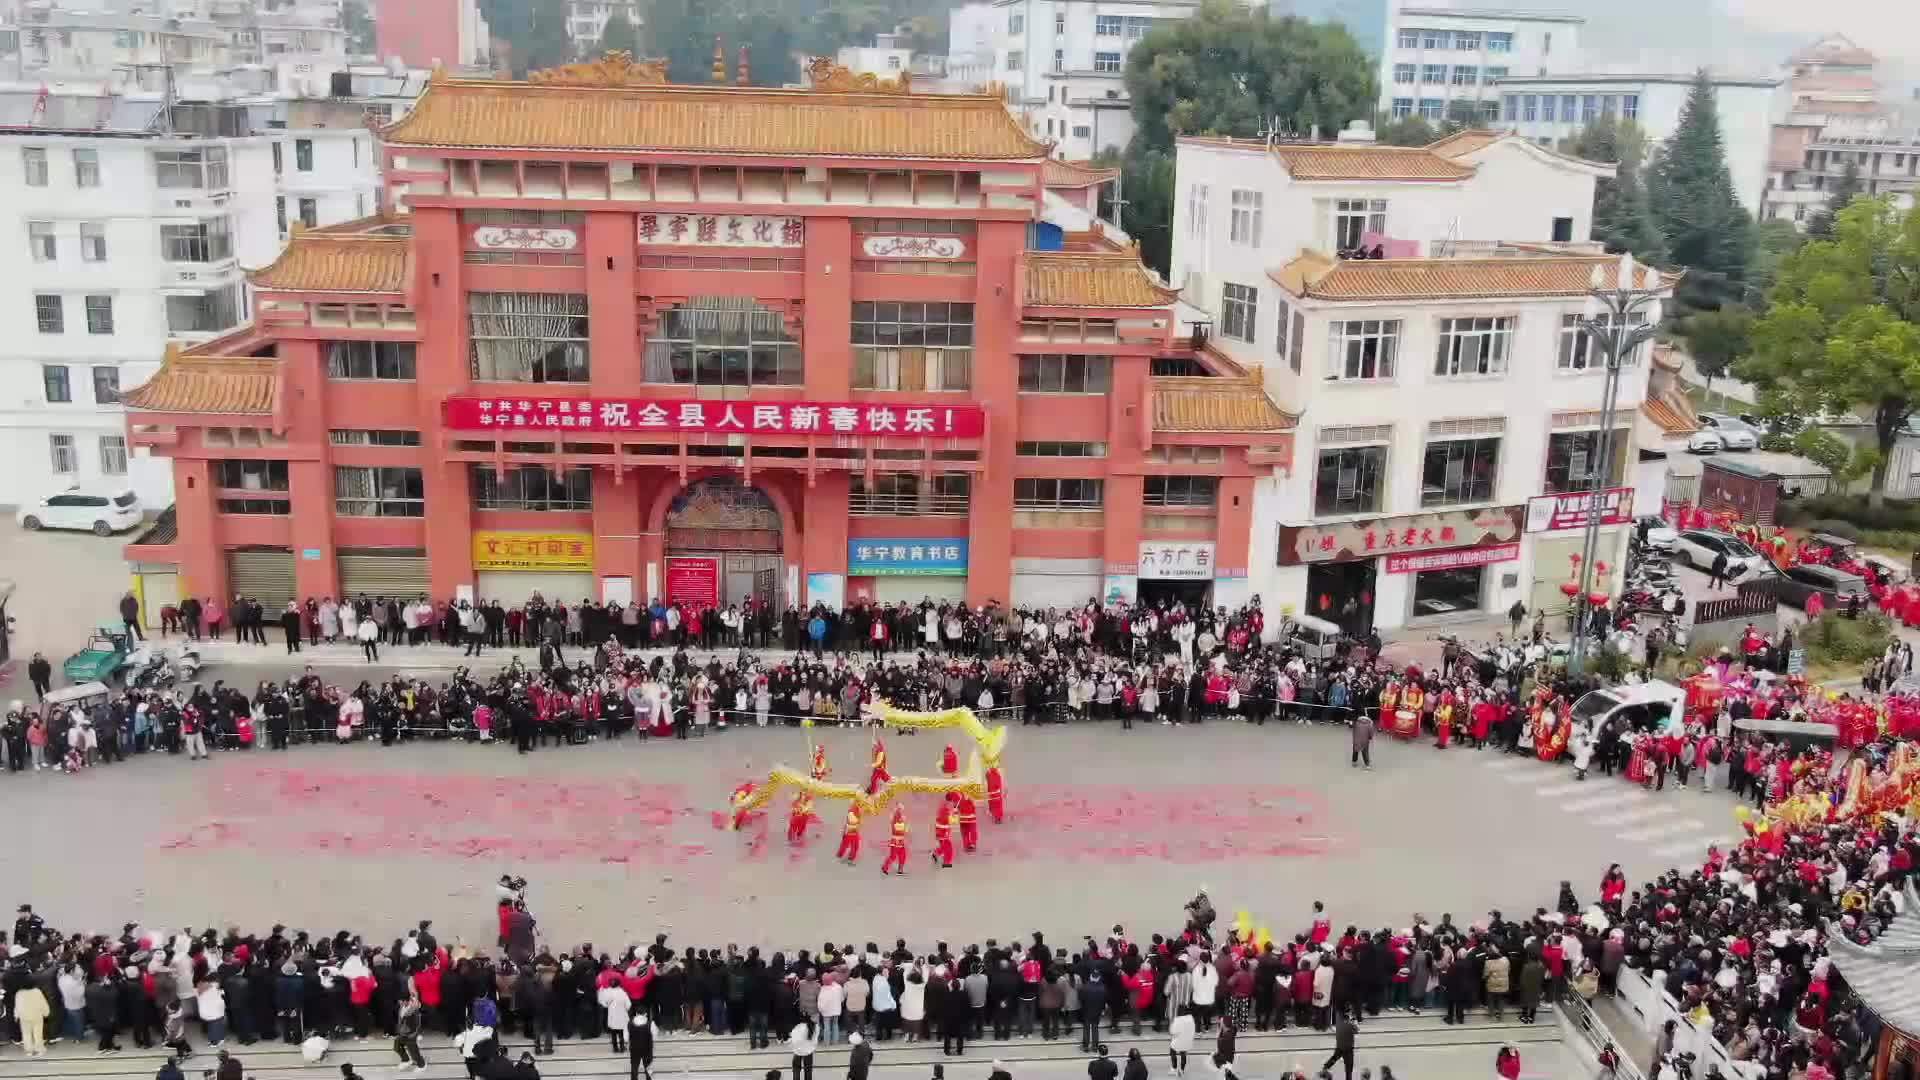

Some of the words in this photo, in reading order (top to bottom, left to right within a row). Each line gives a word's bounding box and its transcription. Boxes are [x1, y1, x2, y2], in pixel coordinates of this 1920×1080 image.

[479, 401, 593, 412] 中共华宁县委
[480, 414, 593, 426] 华宁县人民政府
[857, 545, 960, 561] 华宁教育书店
[1142, 548, 1209, 566] 六方广告
